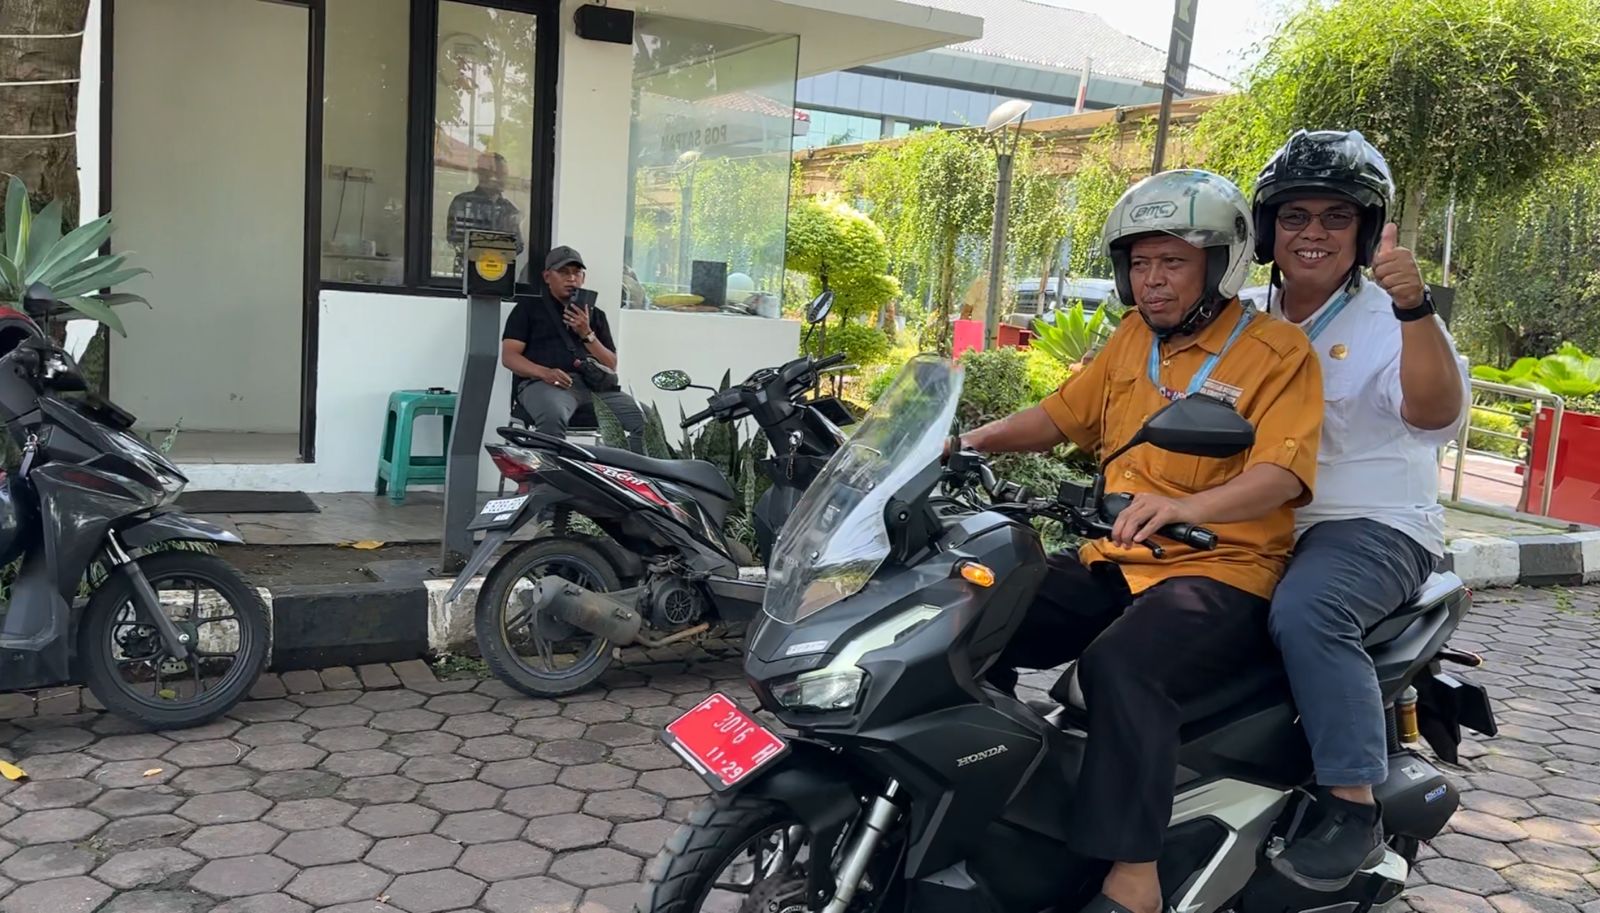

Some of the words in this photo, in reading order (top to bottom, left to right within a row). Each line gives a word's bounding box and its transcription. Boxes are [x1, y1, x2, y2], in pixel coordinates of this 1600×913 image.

[1134, 203, 1173, 219] BMC
[696, 697, 720, 713] F
[713, 711, 755, 745] 3016
[752, 742, 778, 764] H
[956, 744, 1009, 767] HONDA
